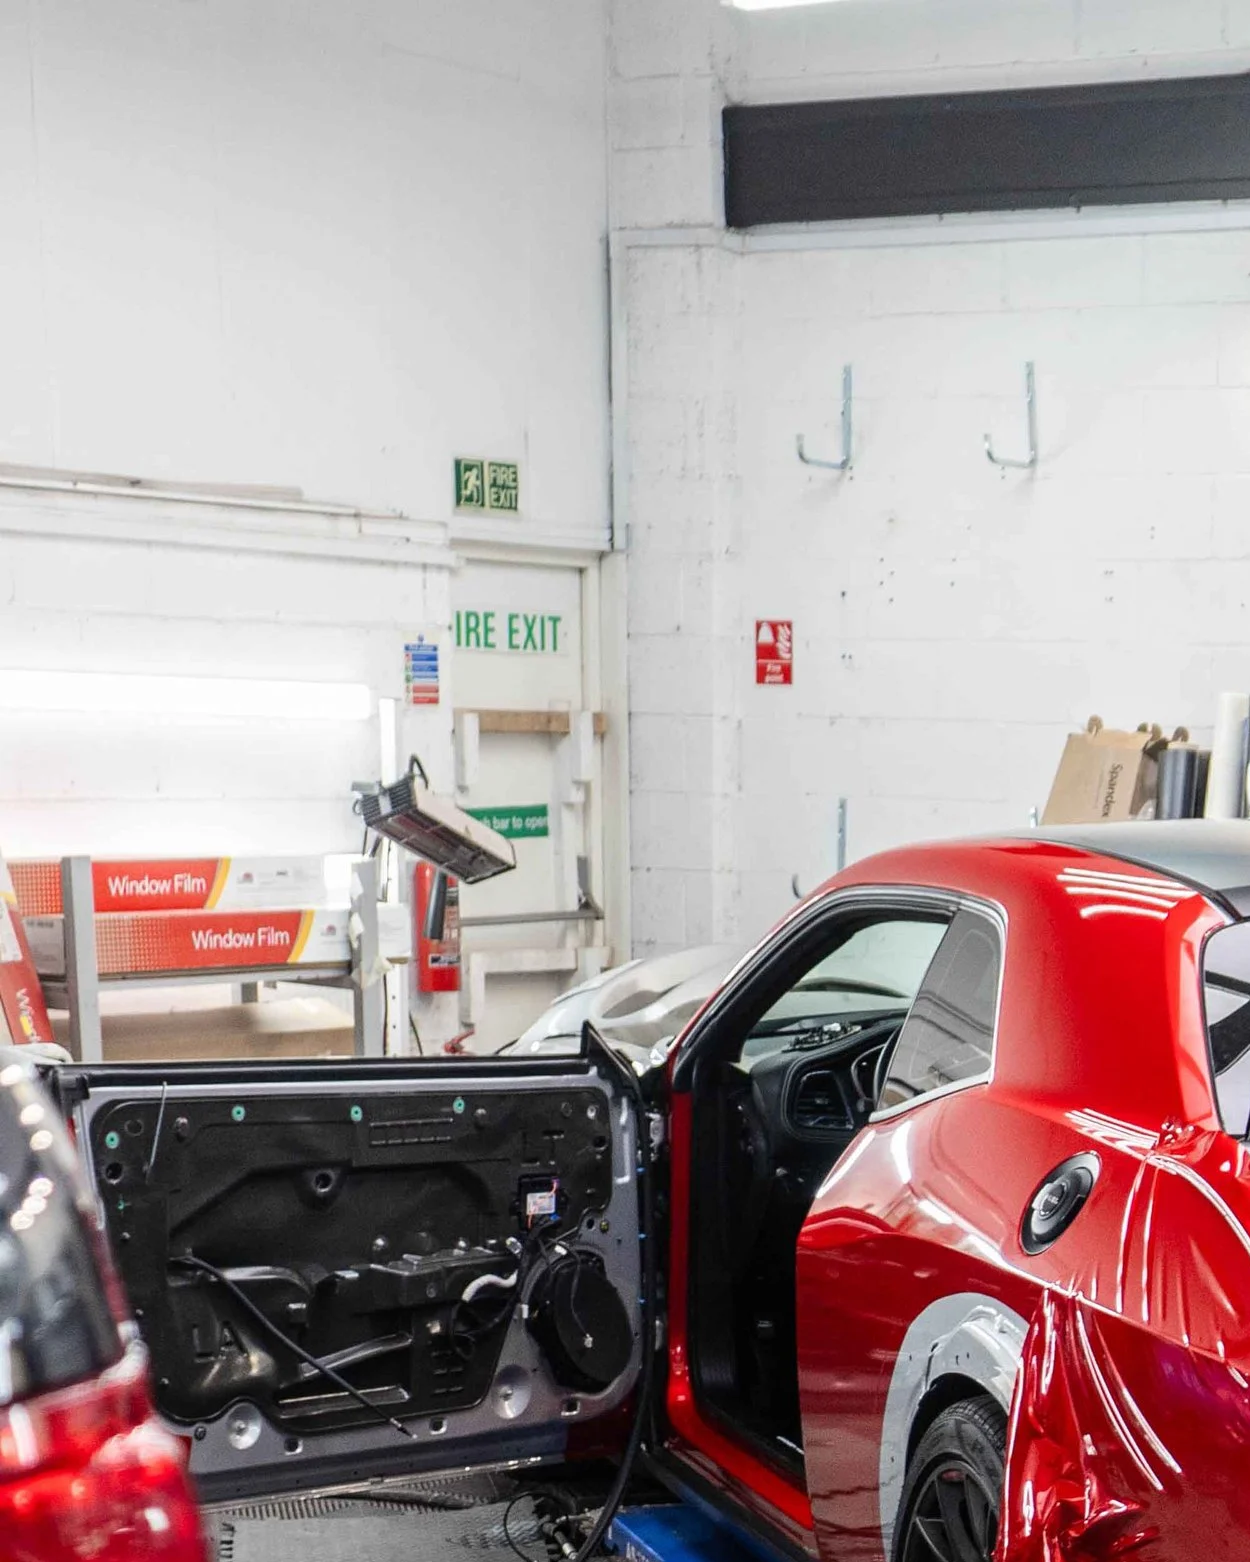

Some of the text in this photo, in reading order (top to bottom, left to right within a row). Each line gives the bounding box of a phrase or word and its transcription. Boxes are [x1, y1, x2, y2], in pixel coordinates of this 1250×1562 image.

[489, 465, 517, 487] FIRE
[490, 486, 517, 508] EXIT
[455, 610, 562, 652] IRE EXIT
[107, 872, 207, 897] Window Film
[191, 926, 290, 950] Window Film
